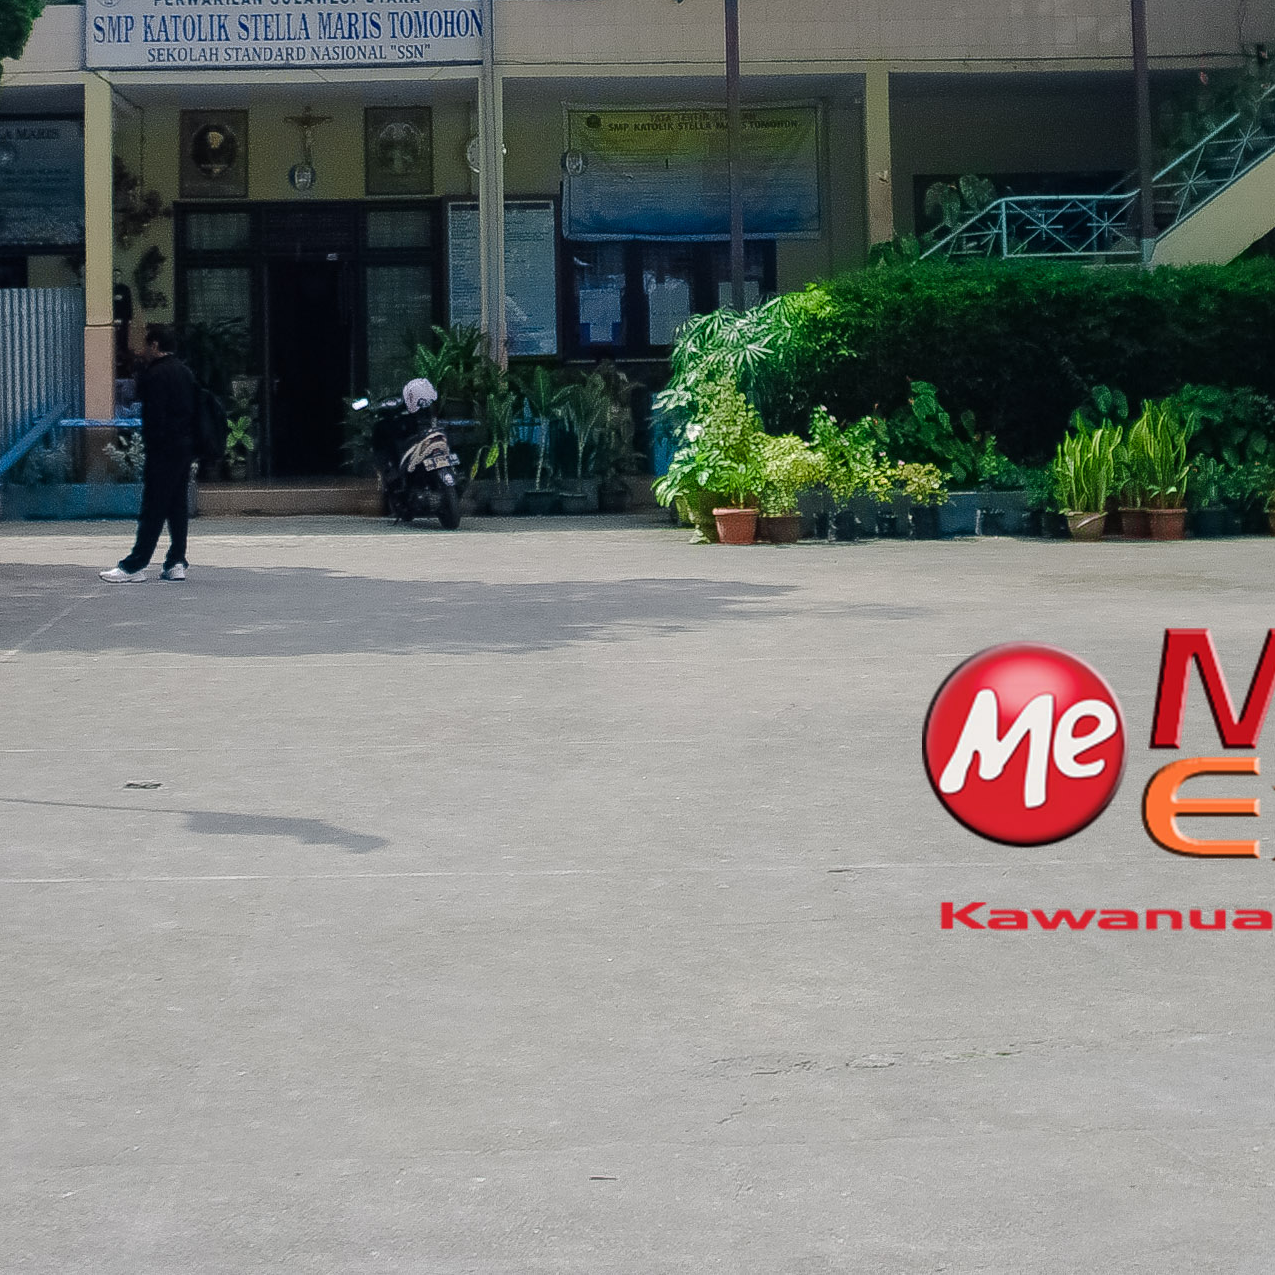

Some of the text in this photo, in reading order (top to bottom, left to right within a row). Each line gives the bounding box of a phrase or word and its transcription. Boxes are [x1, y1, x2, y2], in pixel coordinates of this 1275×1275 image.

[93, 9, 483, 44] SMP KATOLIK STELLA MARIS TOMOHON
[148, 43, 431, 62] SEKOLAH STANDARD NASIONAL "SSN"
